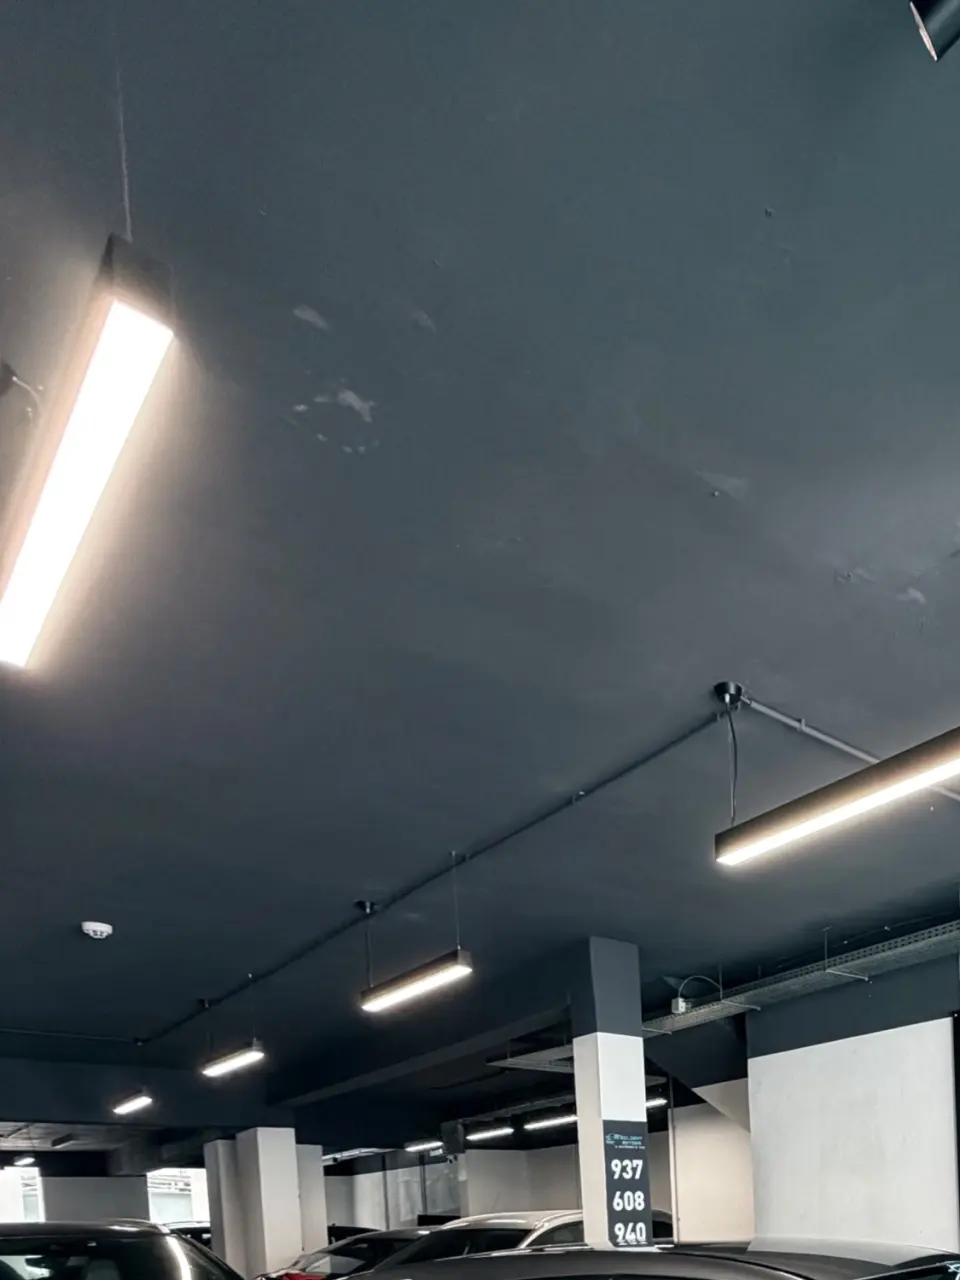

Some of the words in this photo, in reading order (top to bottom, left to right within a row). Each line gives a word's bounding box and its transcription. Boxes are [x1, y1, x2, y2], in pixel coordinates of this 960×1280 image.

[610, 1159, 644, 1180] 937
[612, 1190, 646, 1211] 608
[613, 1221, 648, 1243] 940
